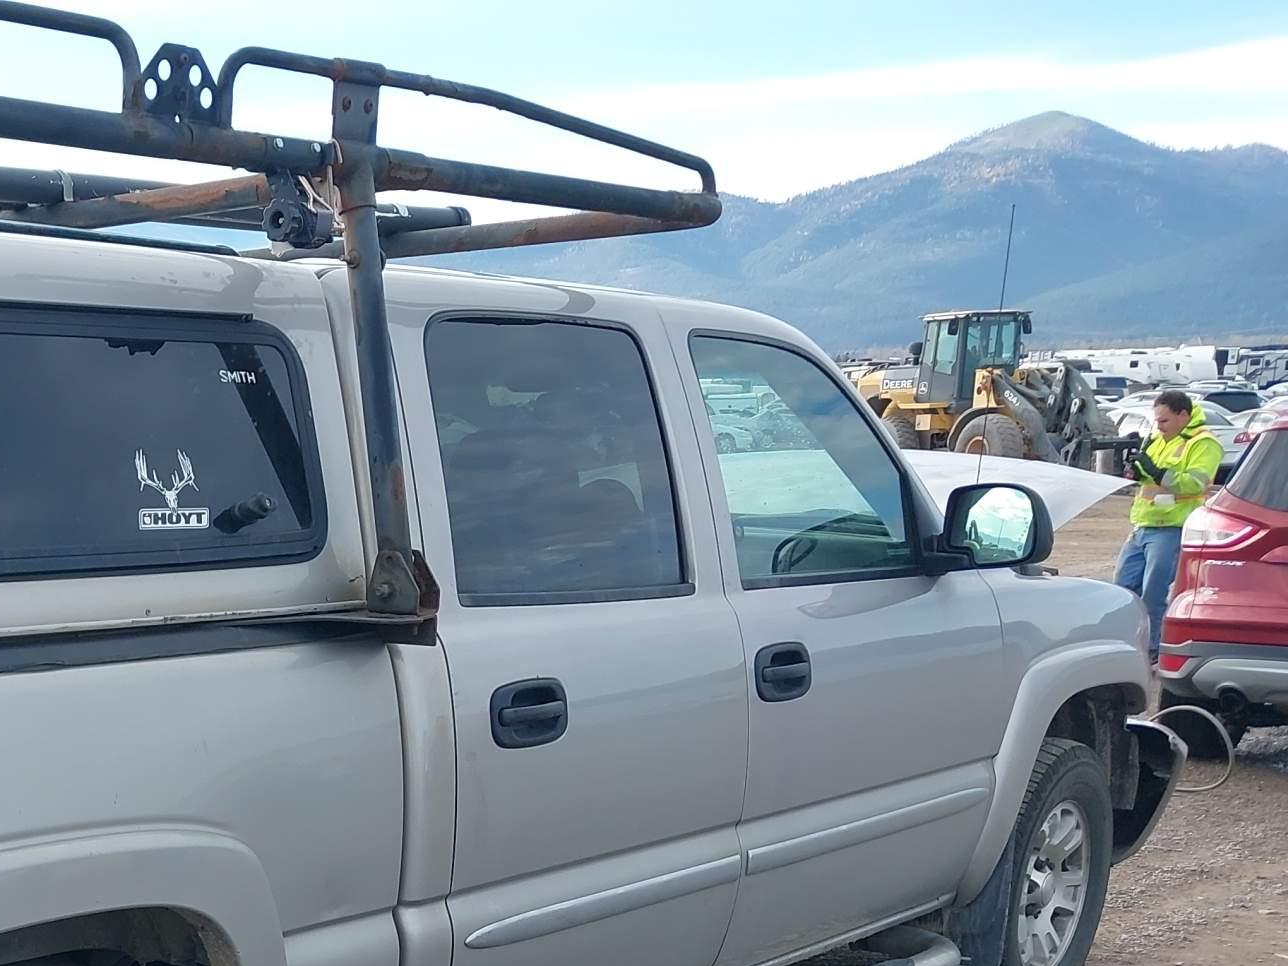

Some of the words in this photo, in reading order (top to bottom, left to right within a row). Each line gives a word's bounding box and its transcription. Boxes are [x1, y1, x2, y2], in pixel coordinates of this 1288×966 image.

[218, 369, 257, 385] SMITH
[883, 379, 914, 390] DEERE
[152, 511, 207, 526] HOYT
